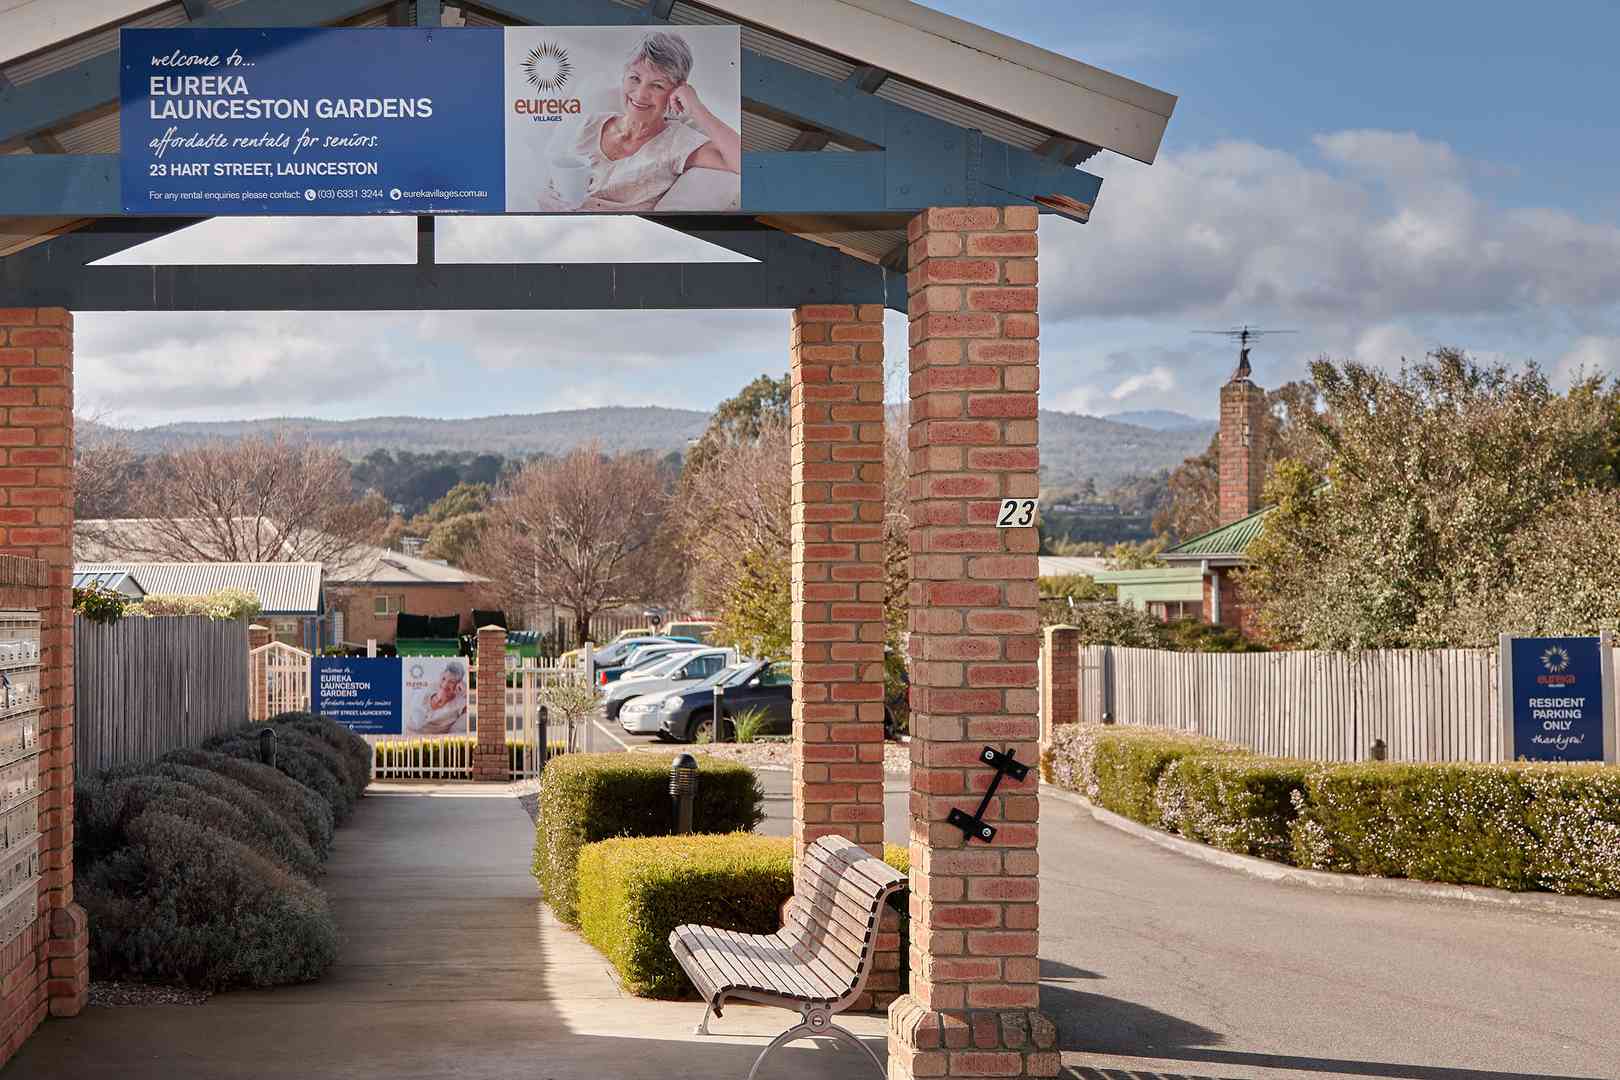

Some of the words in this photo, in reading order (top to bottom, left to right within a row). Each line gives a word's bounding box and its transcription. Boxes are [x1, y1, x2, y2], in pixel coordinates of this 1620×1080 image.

[151, 49, 220, 67] welcome
[150, 76, 249, 96] EUREKA
[150, 99, 309, 119] LAUNCESTON
[315, 98, 433, 119] GARDENS
[514, 98, 581, 114] eureka
[149, 126, 229, 158] affordable
[232, 132, 290, 148] rentals
[293, 127, 320, 155] for
[149, 164, 167, 176] 23
[171, 164, 211, 176] HART
[213, 163, 274, 177] STREET,
[277, 162, 378, 176] LAUNCESTON
[149, 191, 163, 199] For
[164, 192, 179, 201] any
[180, 191, 203, 199] rental
[204, 191, 240, 201] enquiries
[241, 191, 268, 200] please
[318, 189, 335, 199] (03)
[336, 189, 358, 198] 6331
[361, 189, 383, 198] 3244
[1000, 500, 1035, 526] 23
[320, 682, 370, 690] LAUNCESTON
[1529, 698, 1585, 708] RESIDENT
[1533, 709, 1582, 719] PARKING
[1543, 721, 1572, 730] ONLY
